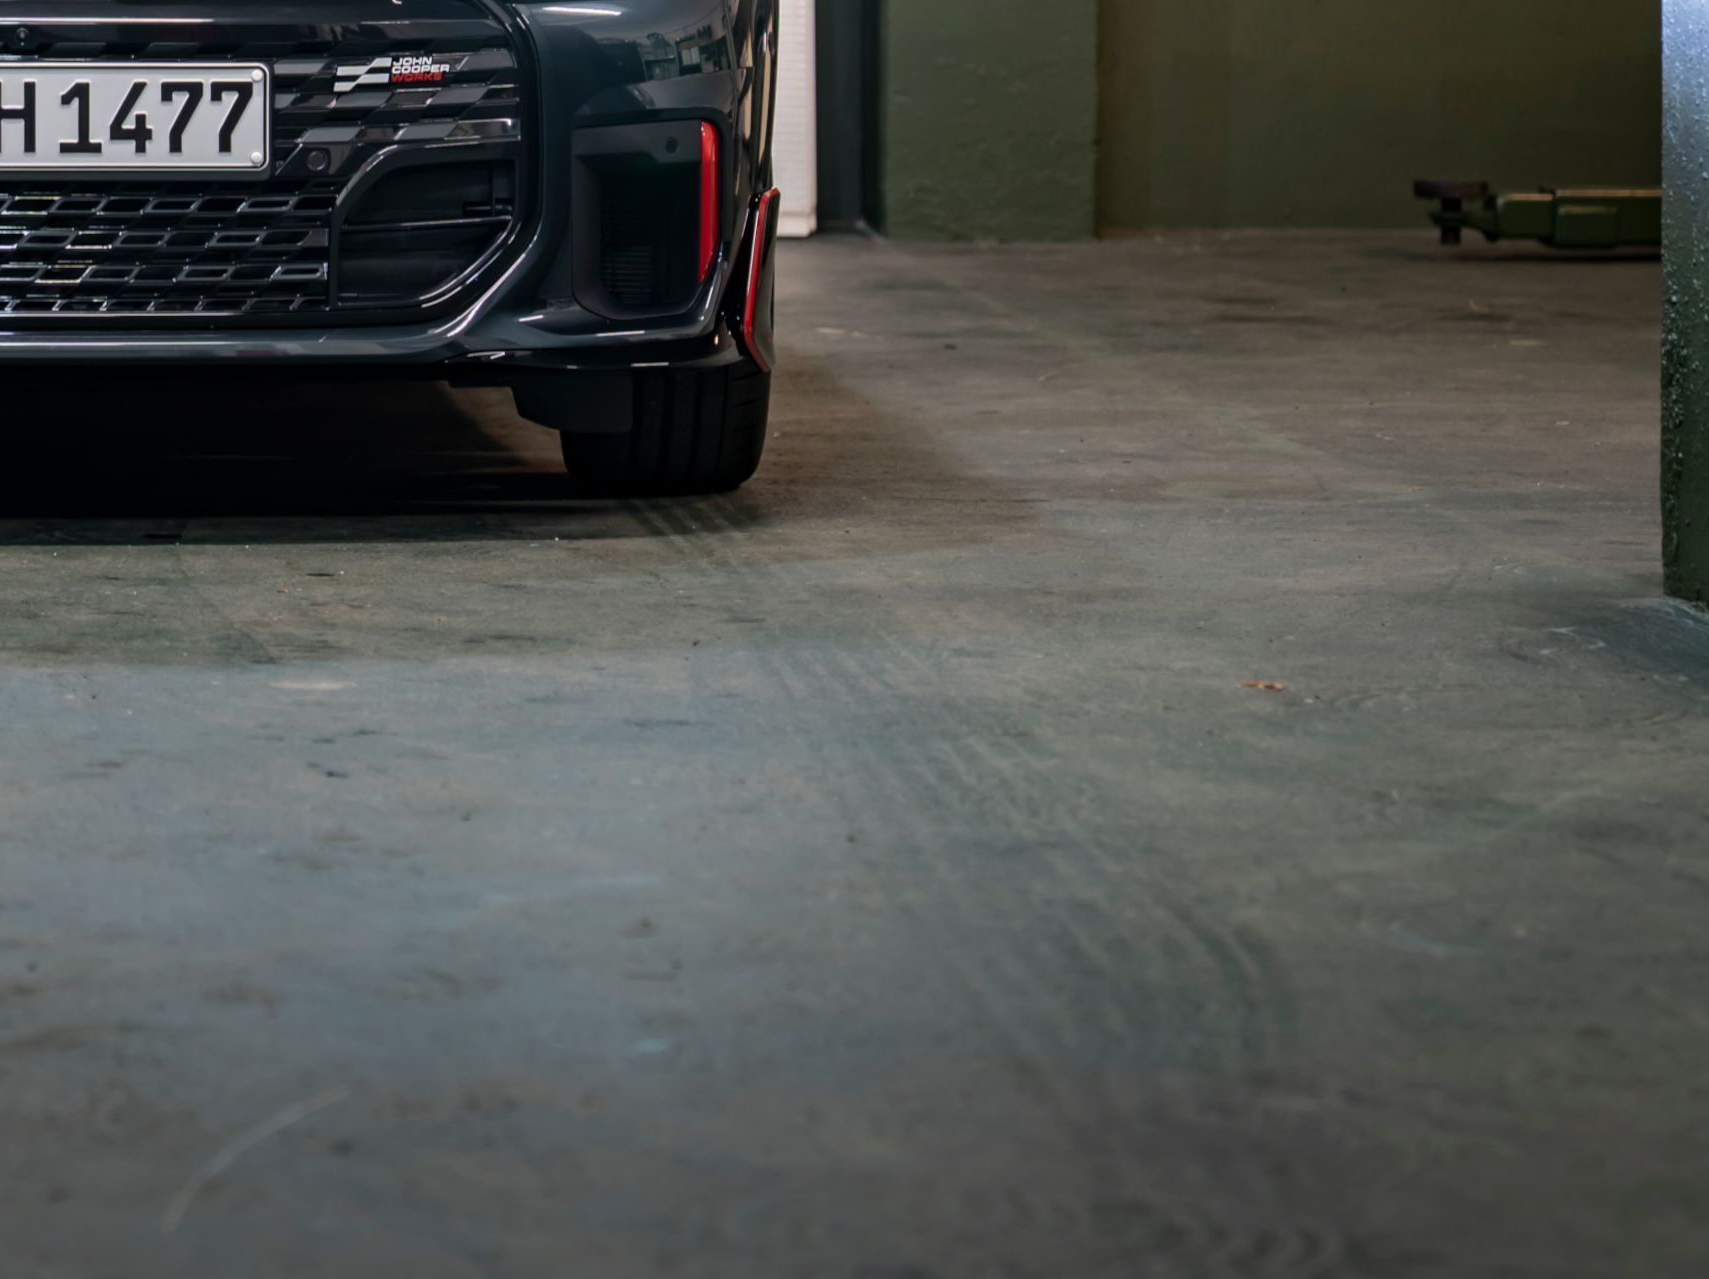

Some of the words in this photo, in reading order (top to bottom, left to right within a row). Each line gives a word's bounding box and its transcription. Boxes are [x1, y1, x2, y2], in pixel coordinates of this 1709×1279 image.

[392, 56, 433, 66] JOHN
[391, 64, 451, 74] COOPER
[391, 72, 444, 83] WORKS
[58, 80, 254, 153] 1477
